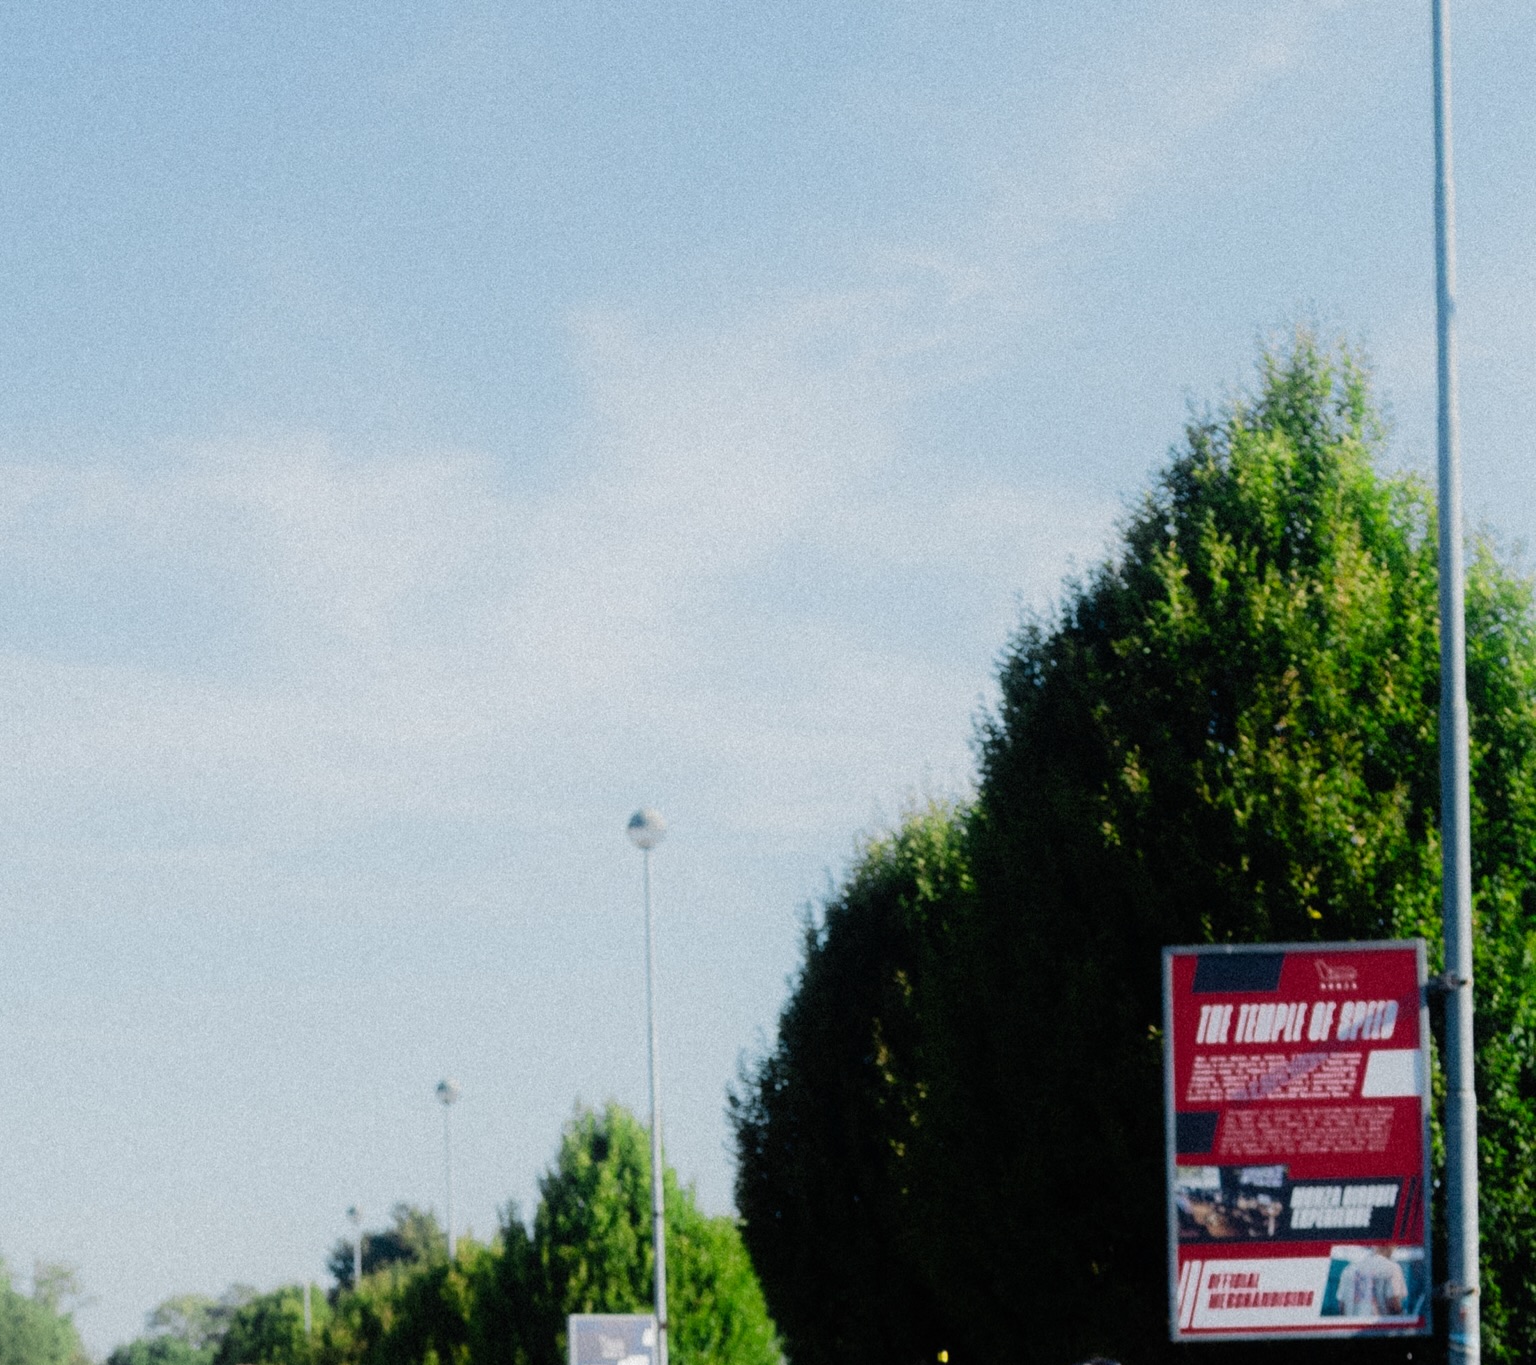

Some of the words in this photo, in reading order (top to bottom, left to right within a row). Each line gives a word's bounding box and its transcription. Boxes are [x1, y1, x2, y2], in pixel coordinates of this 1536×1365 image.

[1196, 1004, 1233, 1044] THE
[1235, 1002, 1308, 1043] TEMPLE
[1308, 1001, 1336, 1041] OF
[1336, 1000, 1398, 1041] SPEED
